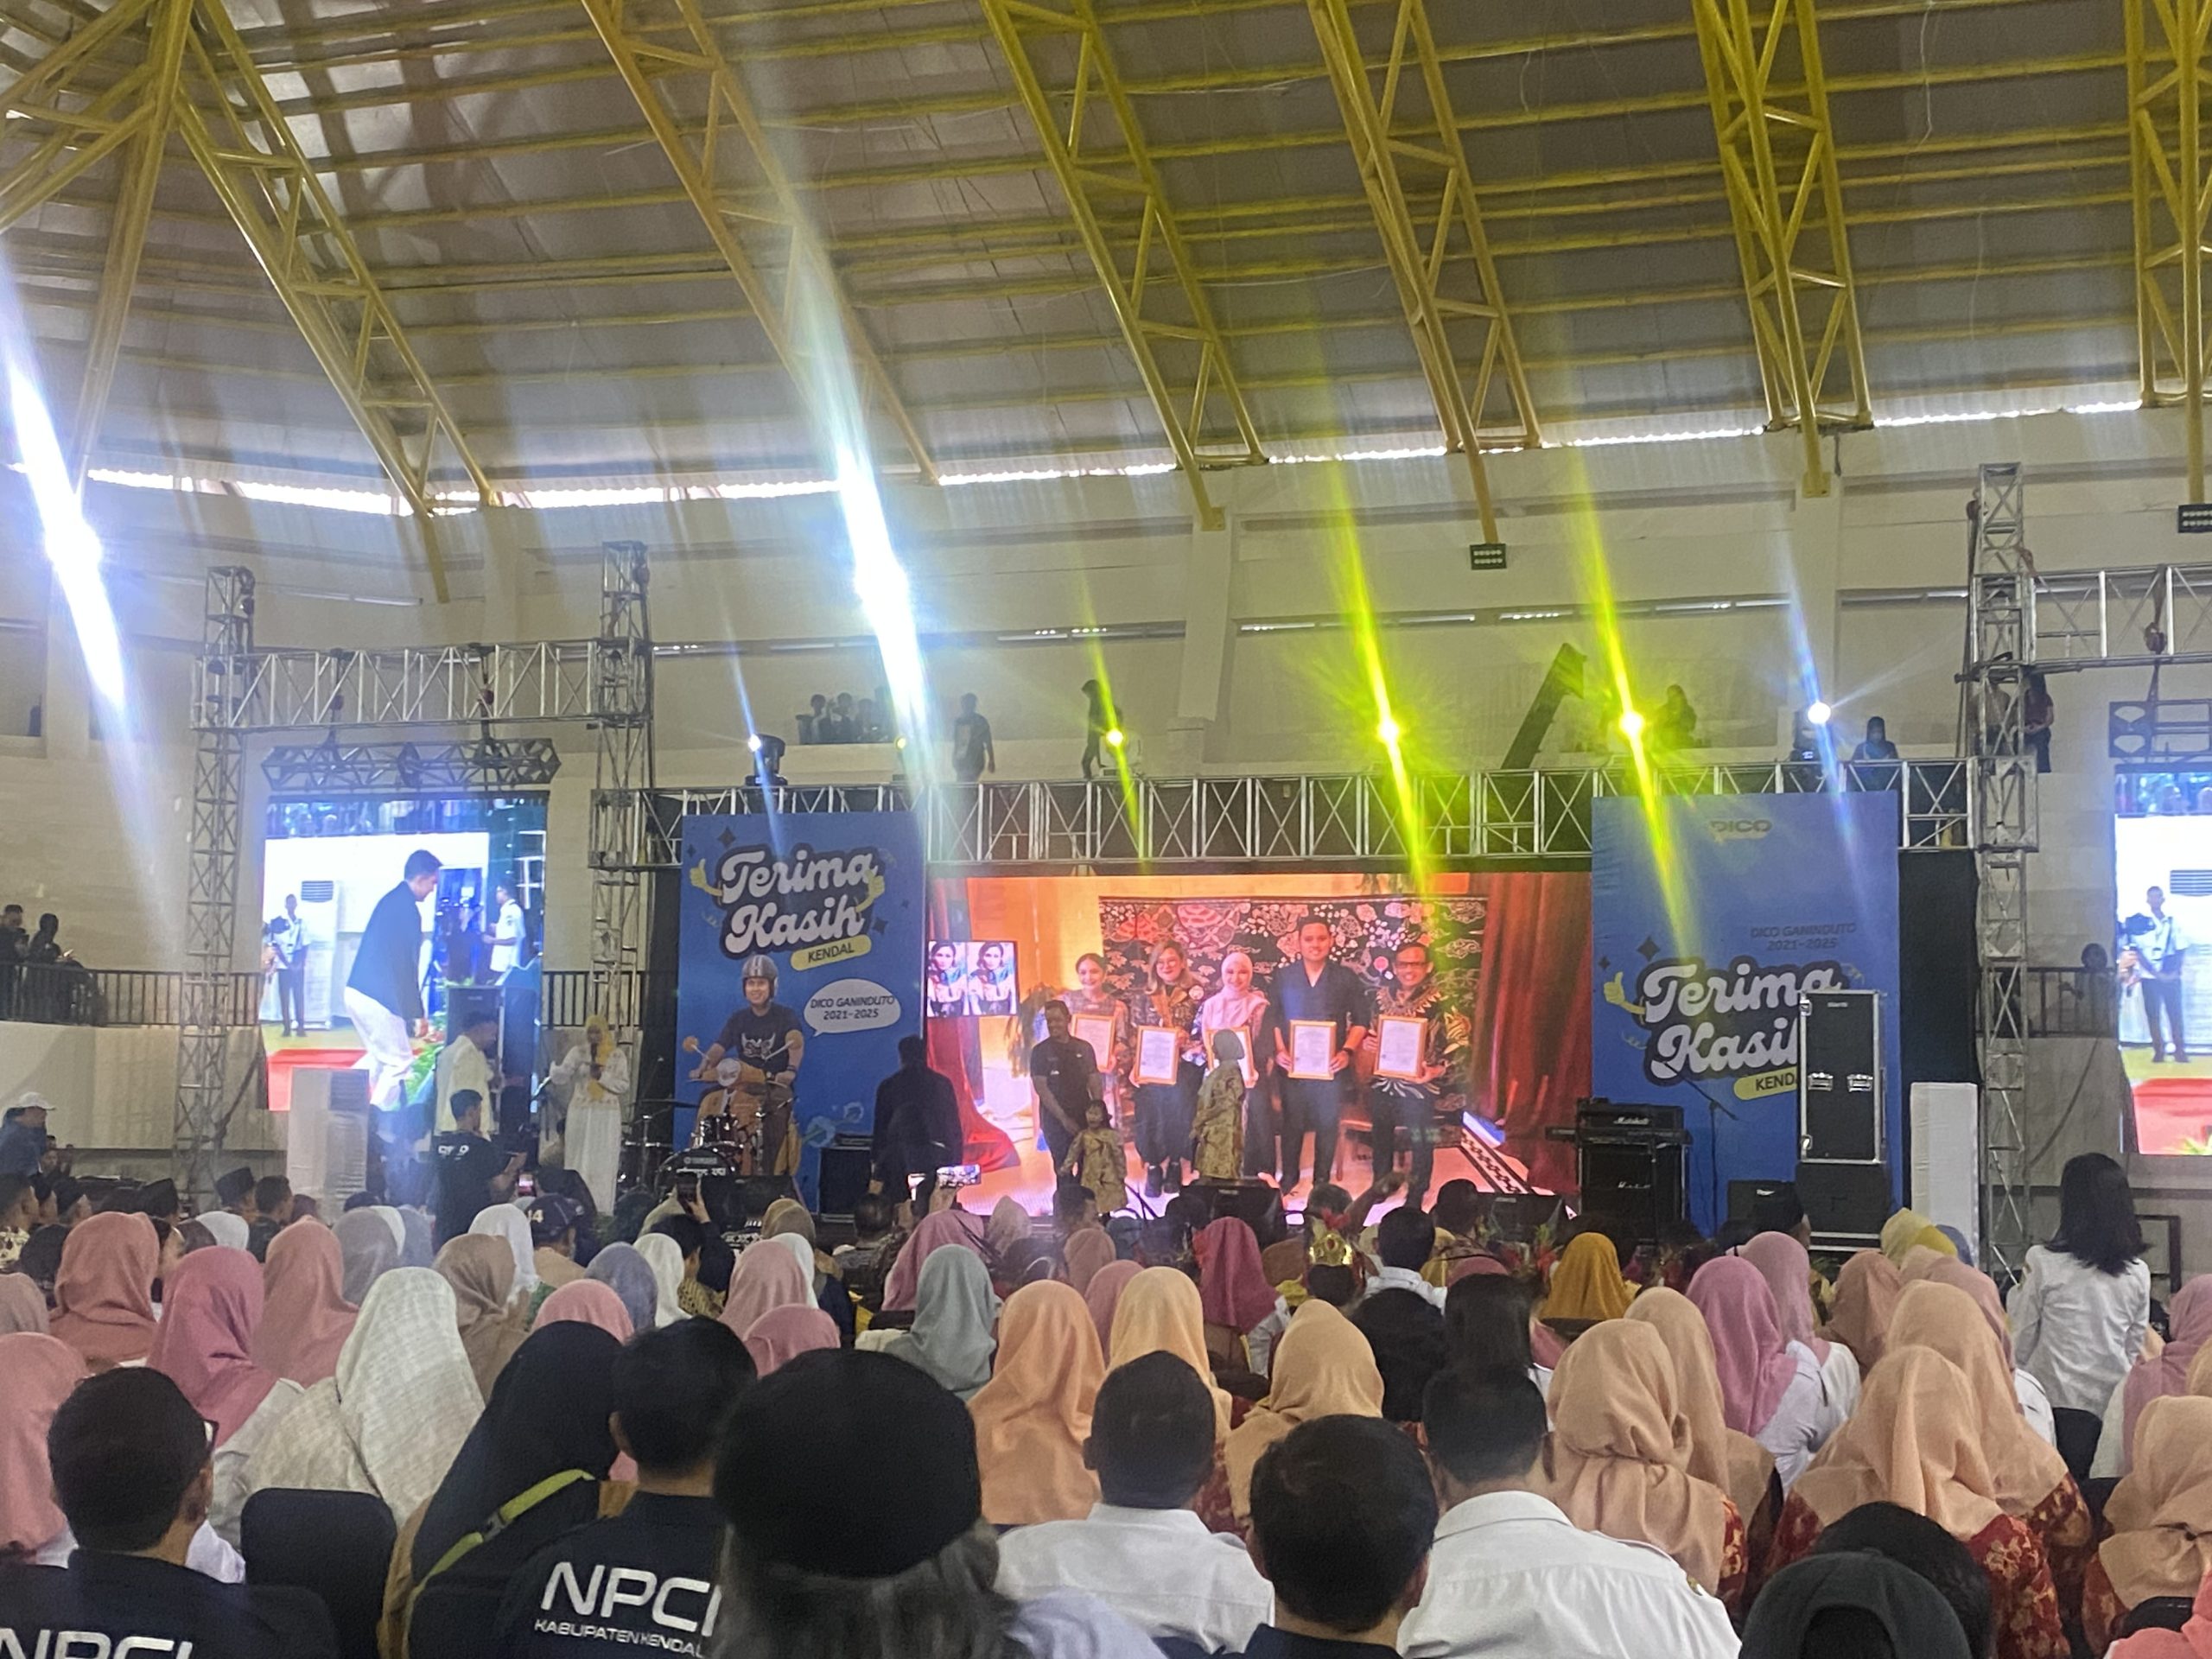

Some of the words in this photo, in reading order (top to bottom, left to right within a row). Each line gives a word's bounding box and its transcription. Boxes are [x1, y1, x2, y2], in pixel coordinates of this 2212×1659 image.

[721, 849, 879, 905] Terima
[724, 893, 865, 954] Kasih
[1751, 925, 1781, 939] DICO
[808, 942, 855, 963] KENDAL
[810, 998, 835, 1009] DICO
[1643, 963, 1842, 1024] Terima
[823, 1007, 880, 1020] 2021-2025
[1755, 1071, 1797, 1092] KEND
[540, 1561, 723, 1637] NPCI
[534, 1618, 639, 1644] KABUPATEN
[639, 1632, 705, 1659] KENDAL
